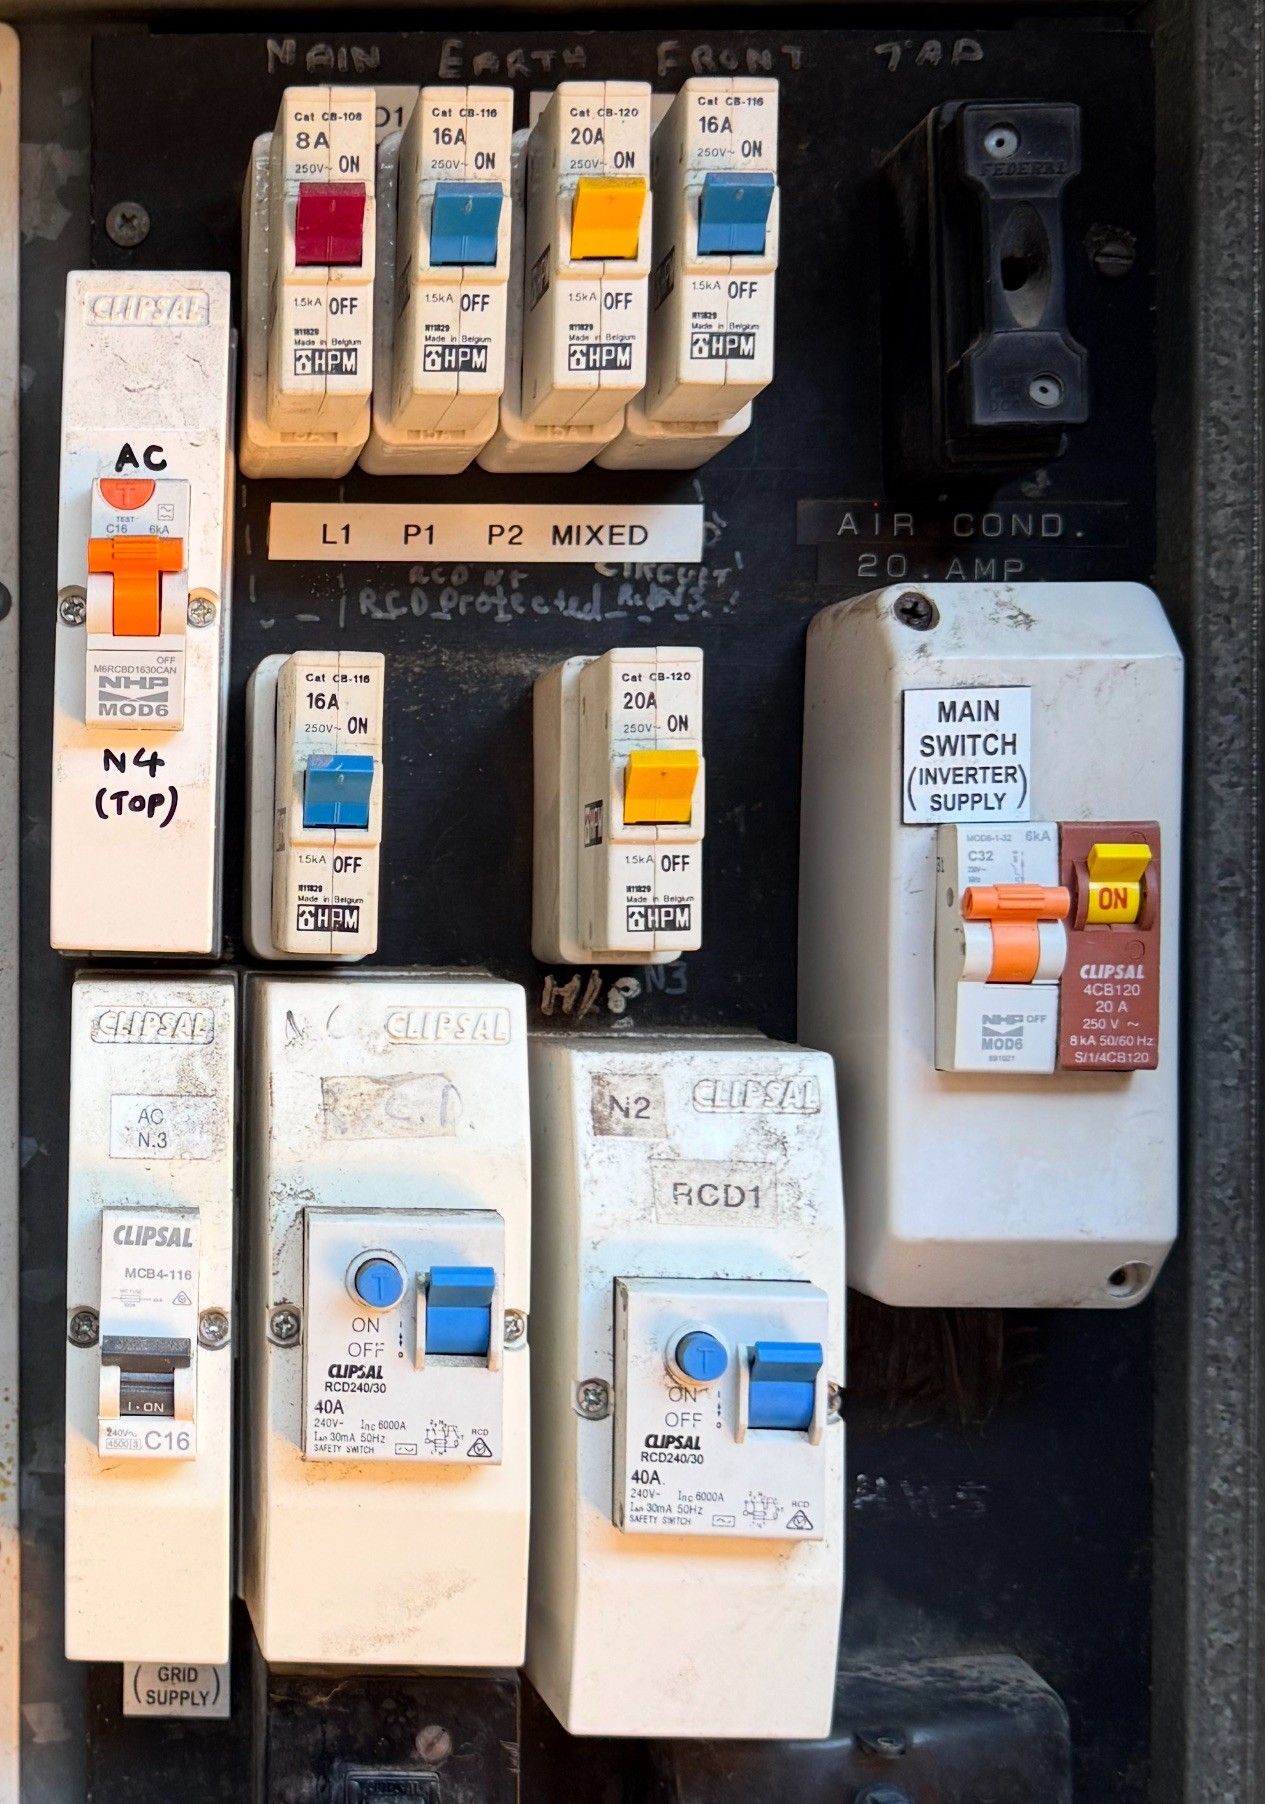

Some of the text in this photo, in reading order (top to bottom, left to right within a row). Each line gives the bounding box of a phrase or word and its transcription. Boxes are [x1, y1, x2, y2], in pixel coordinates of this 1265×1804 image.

[267, 38, 984, 79] MAIN EARTH FRONT TAP
[698, 96, 764, 106] Cat CB-116
[294, 112, 363, 121] Cat CB-108
[432, 107, 498, 118] Cat CB-116
[570, 107, 639, 118] Cat CB-120
[698, 116, 733, 133] 16A
[296, 131, 331, 149] 8A
[432, 127, 466, 145] 16A
[570, 127, 605, 145] 20A
[741, 139, 762, 157] ON
[339, 155, 360, 173] ON
[474, 152, 496, 170] ON
[614, 151, 635, 169] ON
[728, 281, 758, 299] OFF
[92, 294, 203, 323] CLIPSAL
[329, 297, 358, 315] OFF
[460, 294, 490, 312] OFF
[603, 292, 633, 310] OFF
[692, 322, 712, 330] Made
[729, 322, 760, 331] Belgium
[294, 338, 316, 346] Made
[331, 338, 362, 347] Belgium
[425, 335, 446, 343] Made
[462, 335, 492, 344] Belgium
[569, 333, 590, 341] Made
[606, 333, 637, 342] Belgium
[711, 335, 754, 356] HPM
[314, 351, 357, 372] HPM
[444, 347, 487, 369] HPM
[588, 346, 631, 368] HPM
[114, 442, 168, 473] AC
[106, 524, 170, 535] C16 6kA
[836, 511, 1084, 538] AIR COND.
[322, 523, 649, 546] L1 P1 P2 MIXED
[156, 656, 176, 664] OFF
[99, 675, 169, 690] NHP
[306, 673, 371, 684] Cat CB-116
[621, 672, 691, 682] Cat CB-120
[306, 692, 340, 710] 16A
[623, 691, 657, 709] 20A
[98, 702, 169, 717] MOD6
[937, 699, 1000, 723] MAIN
[347, 716, 368, 735] ON
[667, 714, 689, 732] ON
[919, 732, 1018, 758] SWITCH
[1025, 830, 1051, 842] 6kA
[333, 855, 363, 873] OFF
[661, 854, 690, 872] OFF
[967, 850, 994, 862] C32
[297, 895, 319, 903] Made
[334, 895, 364, 905] Belgium
[626, 895, 648, 903] Made
[663, 895, 695, 904] Belgium
[1098, 887, 1128, 910] ON
[316, 908, 359, 929] HPM
[646, 907, 690, 929] HPM
[1079, 964, 1146, 980] CLIPSAL
[1083, 983, 1141, 996] 4CB120
[1095, 1001, 1129, 1013] 20 A
[98, 1009, 207, 1040] CLIPSAL
[386, 1011, 507, 1041] CLIPSAL
[981, 1014, 1047, 1025] NHP OFF
[1082, 1019, 1120, 1030] 250 V
[981, 1037, 1023, 1051] MOD6
[1099, 1035, 1154, 1047] 50/60 Hz
[1074, 1051, 1149, 1064] S/1/4CB120
[694, 1077, 819, 1111] CLIPSAL
[609, 1094, 652, 1120] N2
[137, 1108, 164, 1125] AC
[137, 1131, 168, 1149] N.3
[672, 1181, 761, 1209] RCD1
[113, 1224, 193, 1248] CLIPSAL
[125, 1267, 193, 1281] MCB4-116
[351, 1317, 380, 1333] ON
[347, 1342, 385, 1358] OFF
[327, 1363, 384, 1380] CLIPSAL
[324, 1381, 387, 1393] RCD240/30
[667, 1386, 697, 1403] ON
[314, 1399, 344, 1415] 40A
[378, 1420, 407, 1430] 6000A
[664, 1411, 703, 1427] OFF
[144, 1430, 190, 1451] C16
[329, 1432, 386, 1444] 30mA 50Hz
[471, 1428, 489, 1436] RCD
[314, 1444, 375, 1454] SAFETY SWITCH
[644, 1433, 702, 1450] CLIPSAL
[640, 1451, 704, 1465] RCD240/30
[695, 1491, 725, 1502] 6000A
[791, 1500, 810, 1508] RCD
[646, 1503, 703, 1515] 30mA 50Hz
[629, 1514, 692, 1526] SAFETY SWITCH
[157, 1666, 199, 1683] GRID
